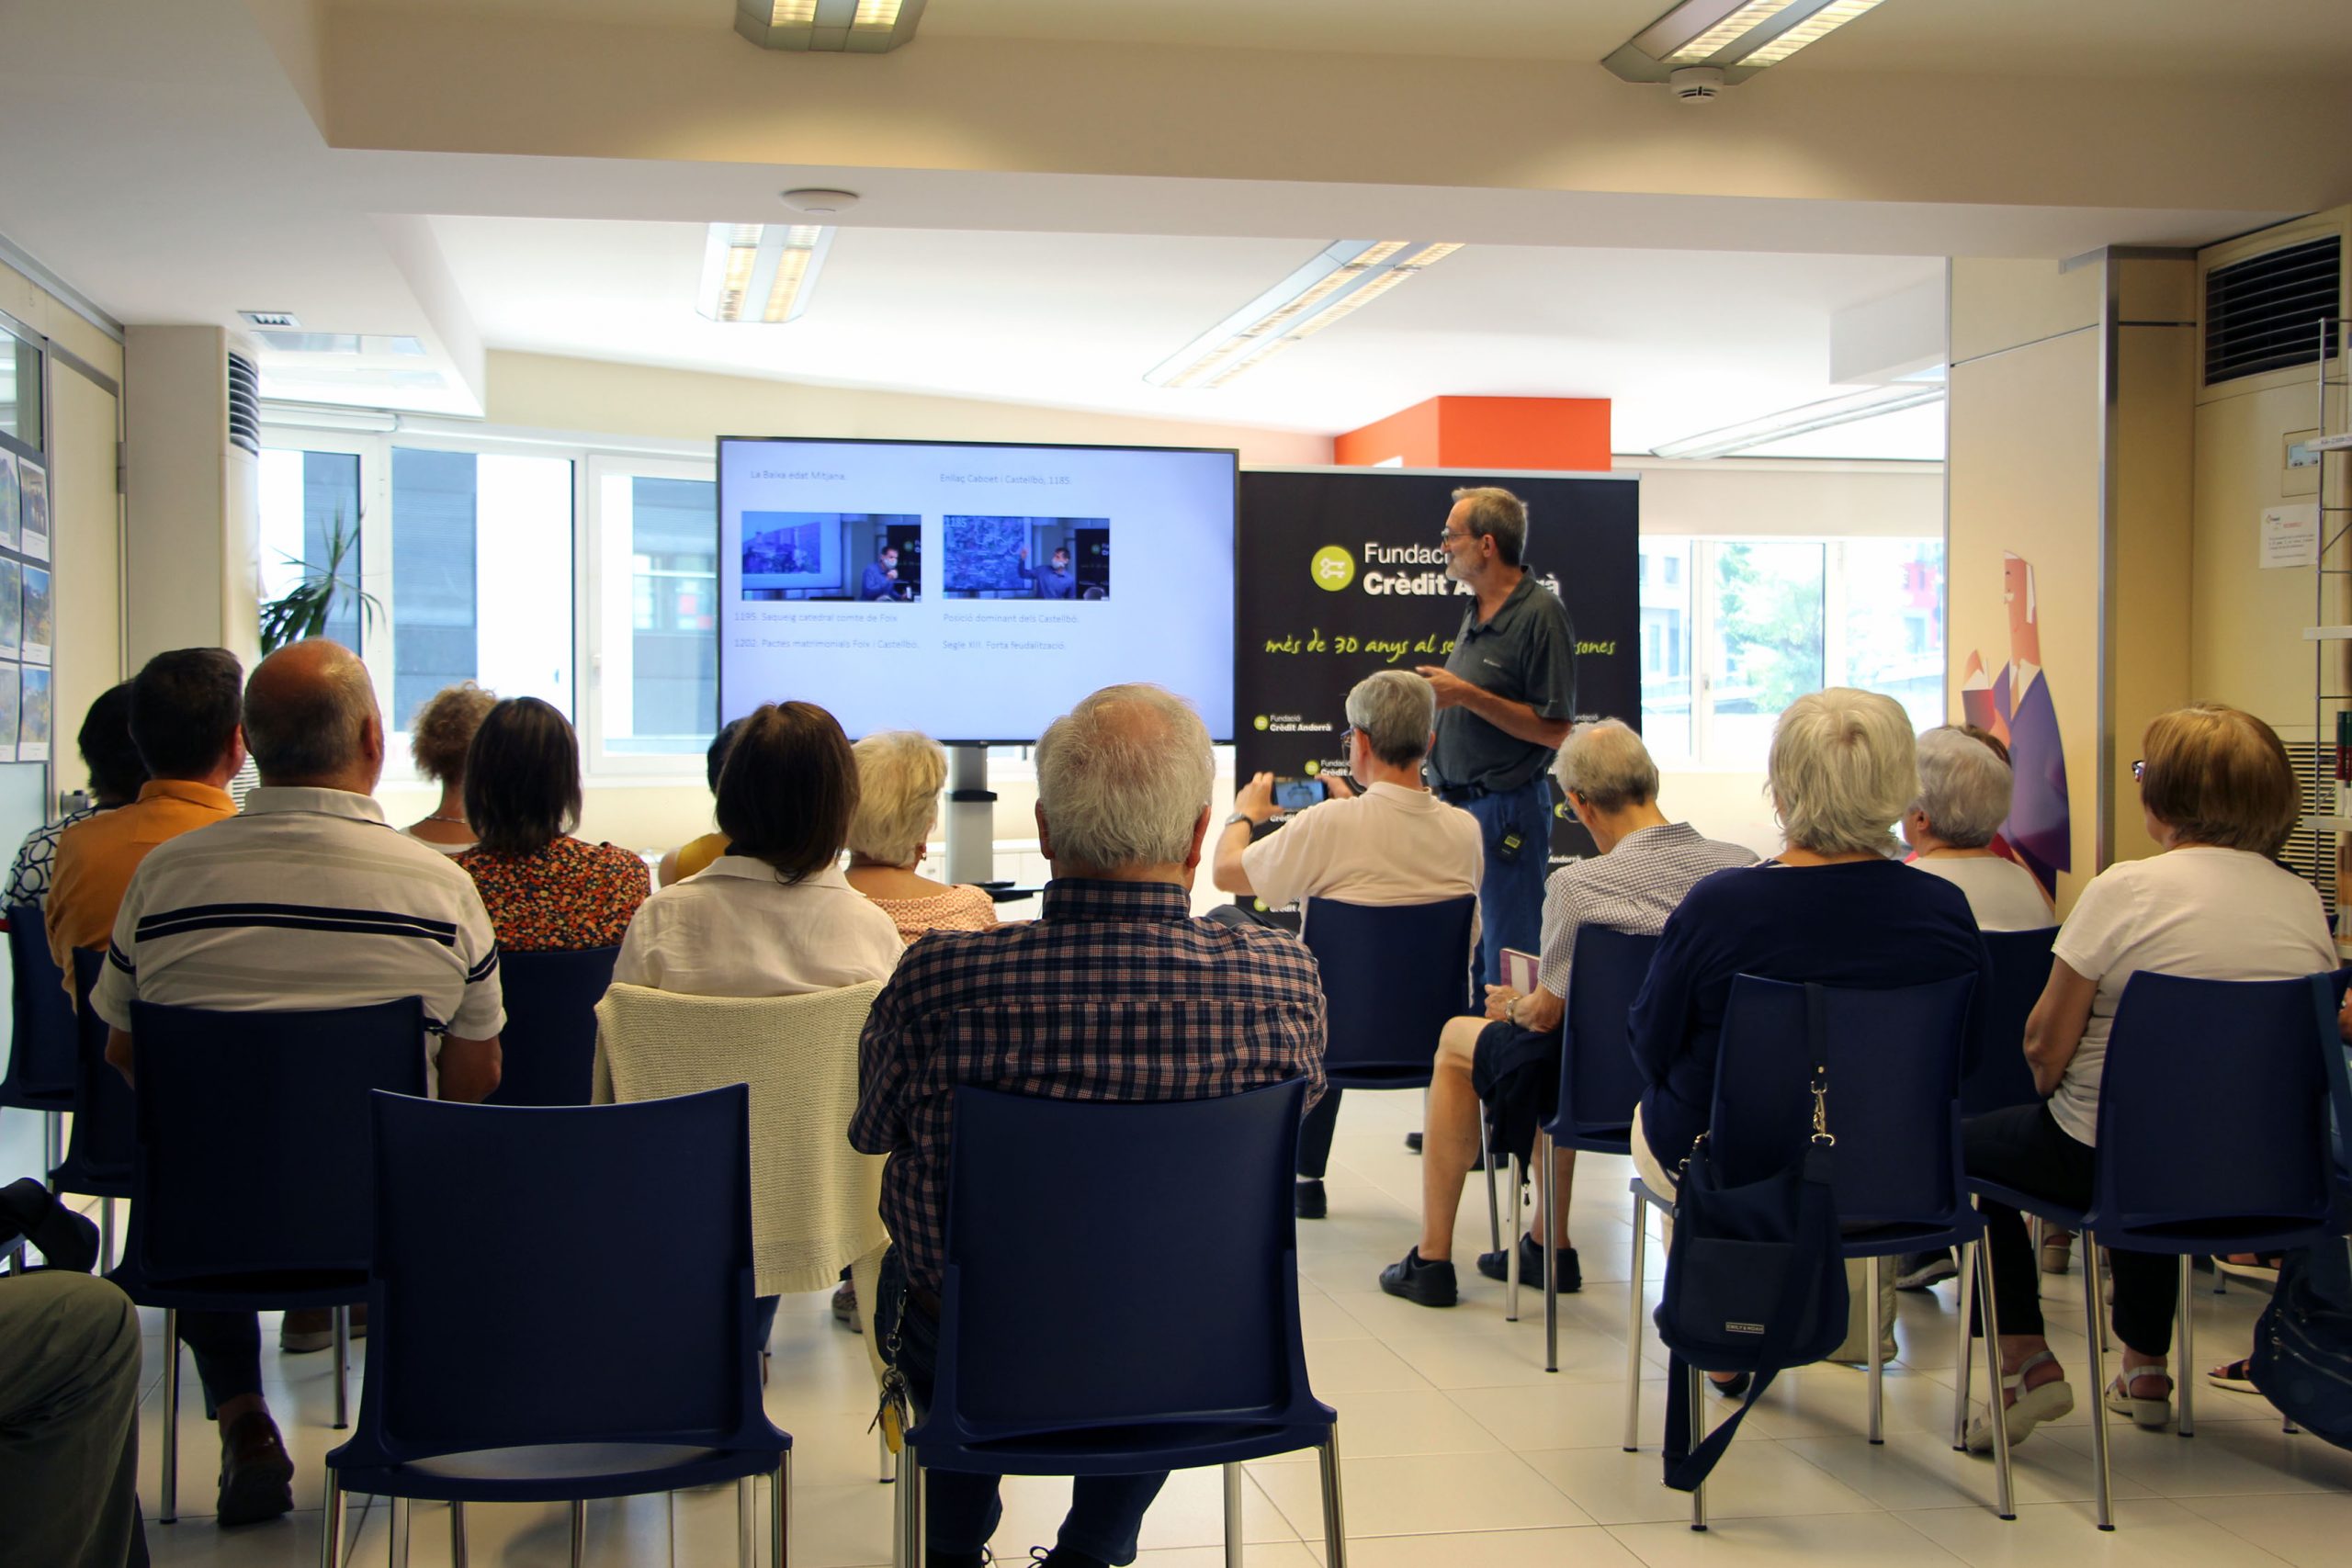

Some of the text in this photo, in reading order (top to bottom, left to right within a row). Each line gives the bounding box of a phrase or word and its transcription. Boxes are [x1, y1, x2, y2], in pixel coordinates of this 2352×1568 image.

[750, 470, 761, 479] La
[1364, 544, 1448, 564] Fundaci
[1363, 571, 1447, 596] Crèdit
[975, 613, 1017, 623] dominant
[1306, 628, 1326, 652] de
[1334, 637, 1357, 654] 30
[1364, 640, 1409, 663] anys
[1413, 634, 1436, 653] al
[1575, 640, 1616, 655] sones
